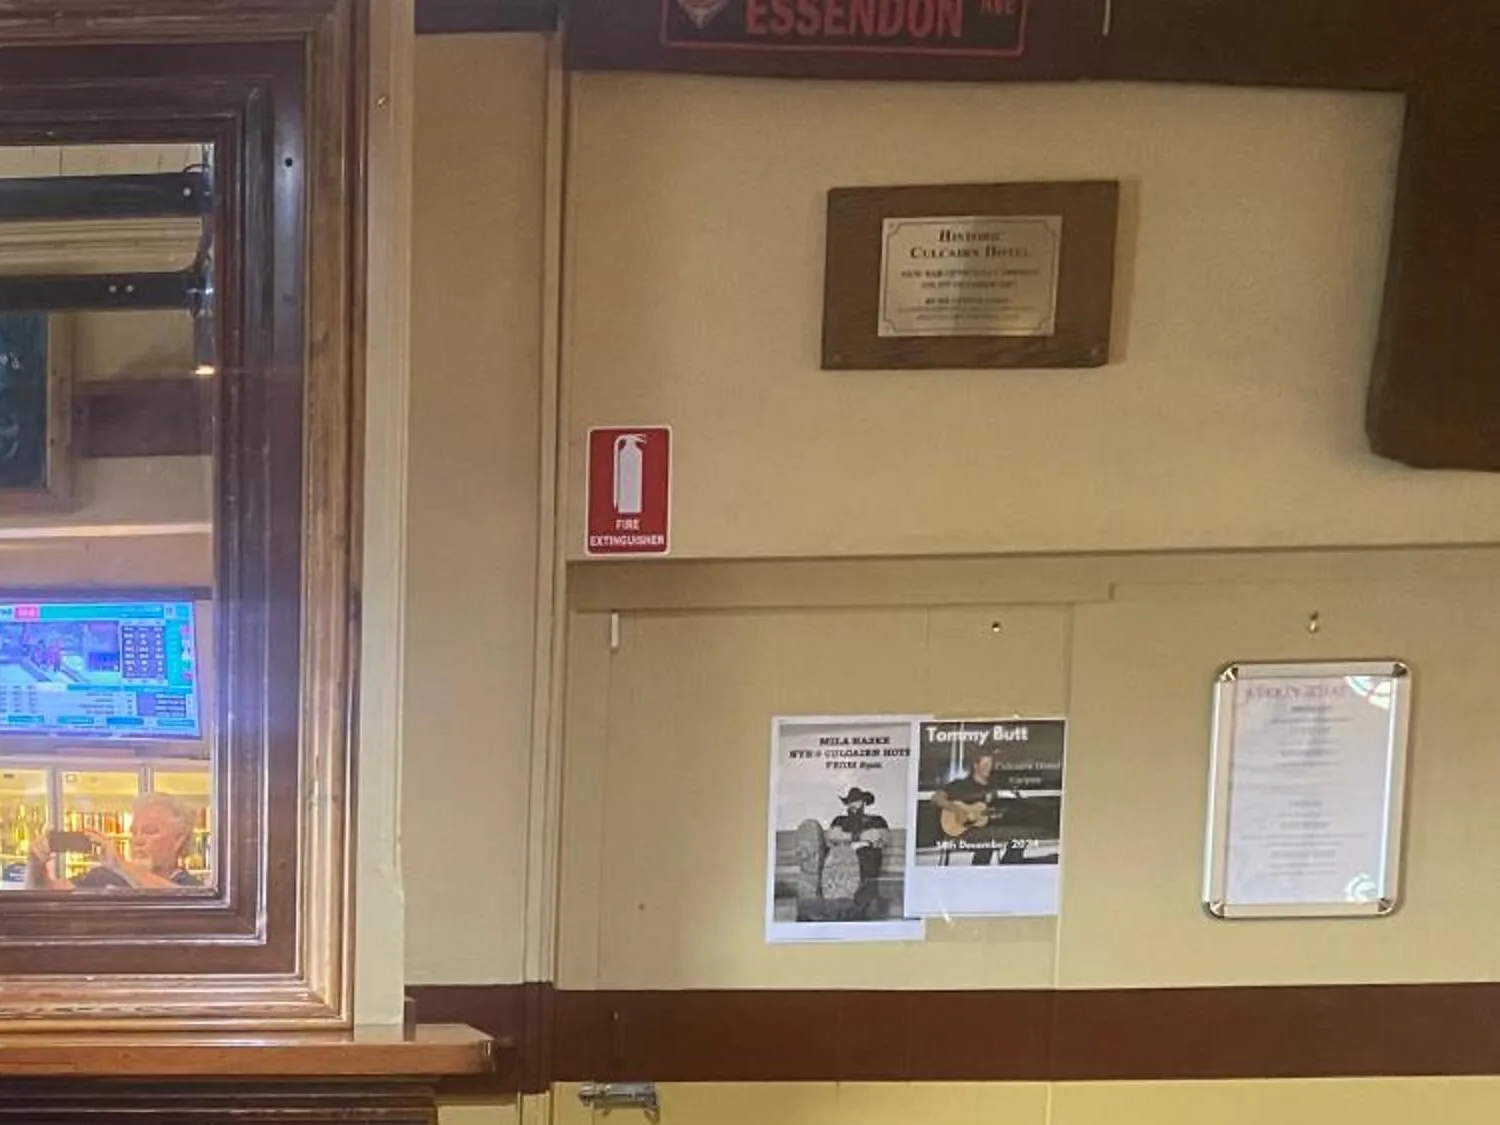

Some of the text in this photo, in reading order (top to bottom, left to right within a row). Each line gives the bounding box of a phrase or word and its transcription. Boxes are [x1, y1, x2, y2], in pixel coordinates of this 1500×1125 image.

[745, 0, 963, 37] ESSENDON
[615, 518, 640, 531] FIRE
[589, 533, 665, 547] EXTINGUISHER
[925, 726, 1029, 746] Tommy Butt
